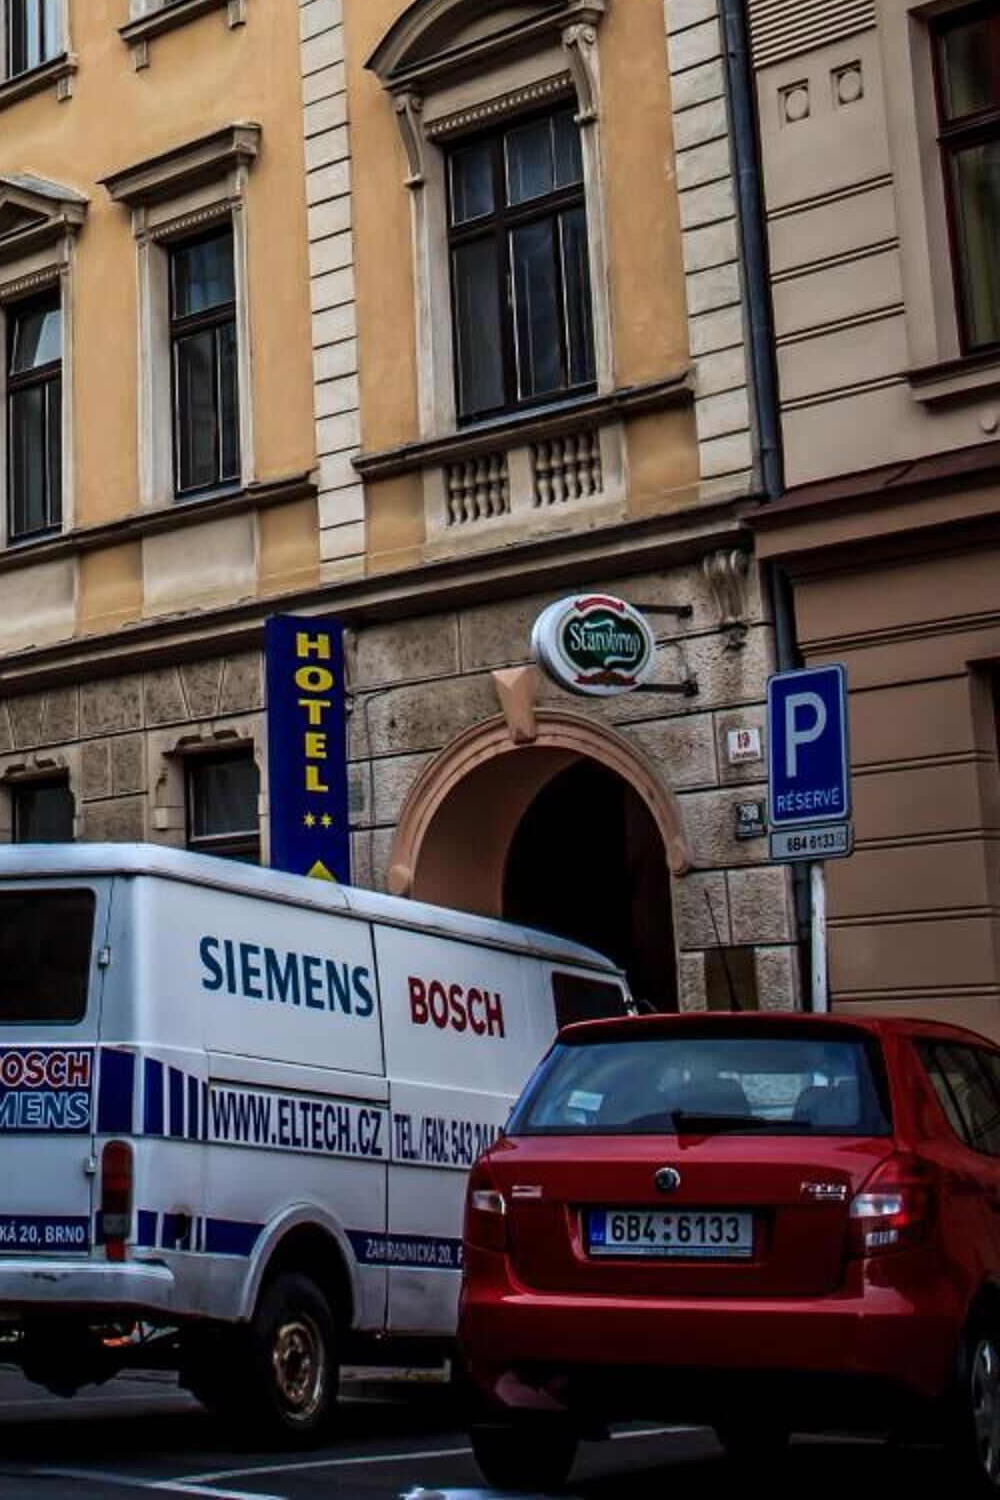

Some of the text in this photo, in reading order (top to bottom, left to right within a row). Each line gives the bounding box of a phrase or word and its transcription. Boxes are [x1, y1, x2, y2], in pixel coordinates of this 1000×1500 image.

[294, 632, 333, 793] HOTEL
[785, 691, 827, 778] P
[199, 935, 375, 1018] SIEMENS
[408, 976, 505, 1038] BOSCH
[210, 1086, 383, 1157] WWW.ELTECH.CZ
[451, 1121, 473, 1165] 543
[20, 1224, 41, 1244] 20,
[44, 1223, 86, 1244] BRNO
[611, 1215, 740, 1243] 6B4 6133
